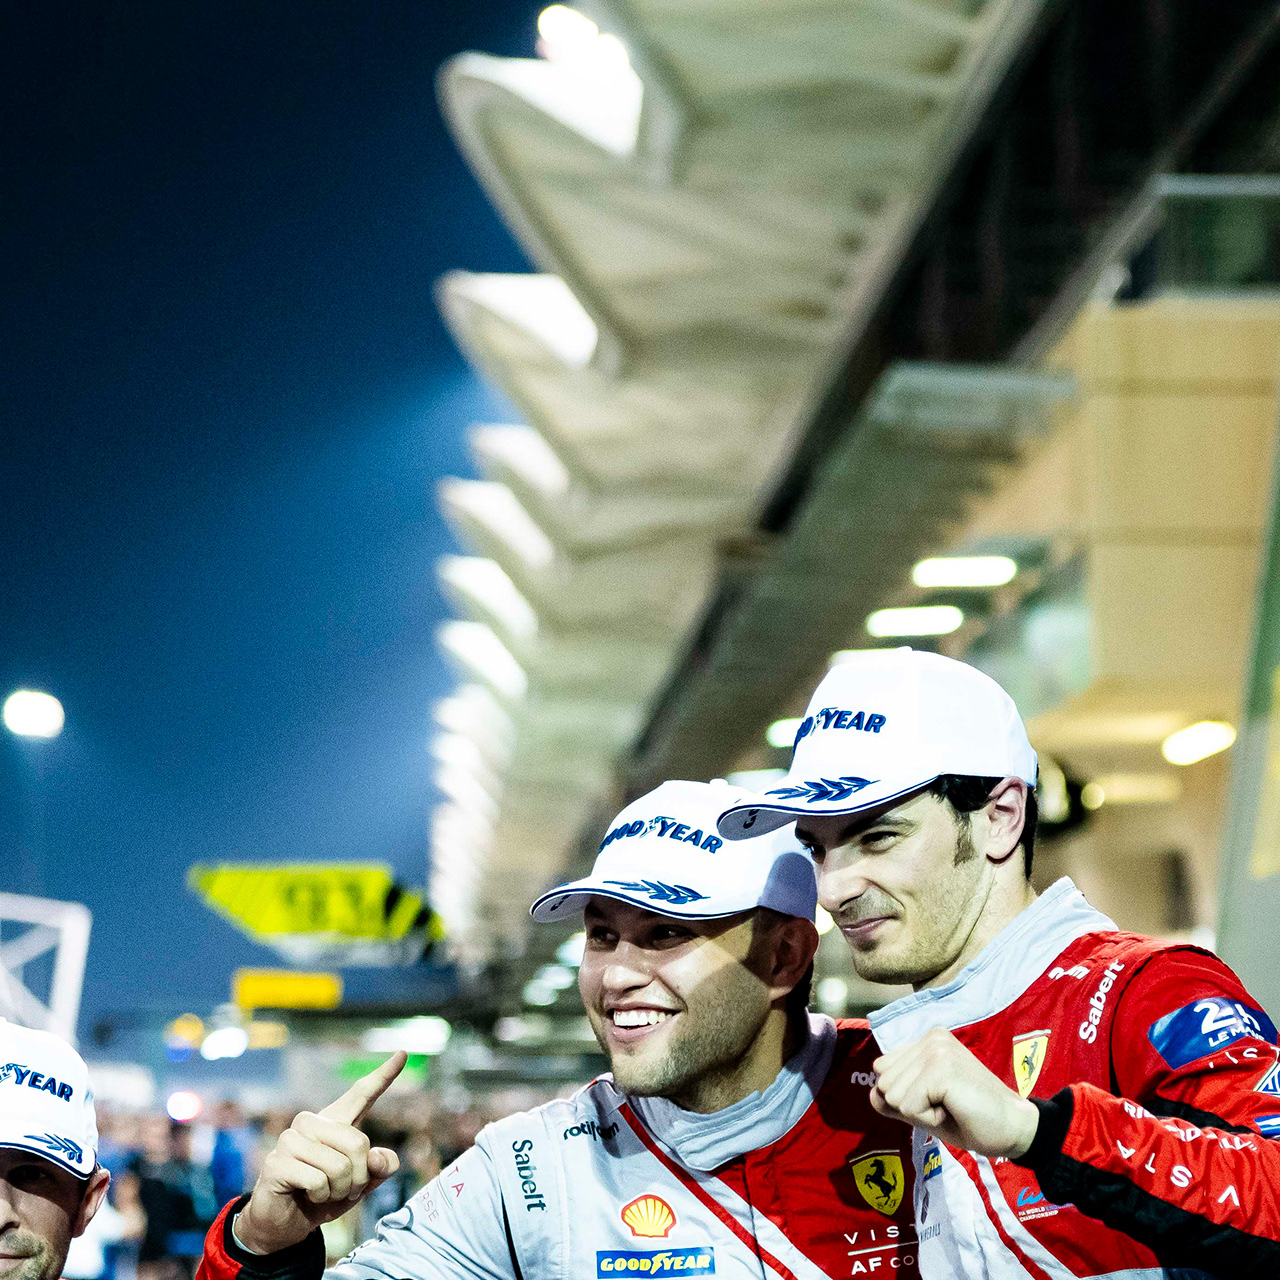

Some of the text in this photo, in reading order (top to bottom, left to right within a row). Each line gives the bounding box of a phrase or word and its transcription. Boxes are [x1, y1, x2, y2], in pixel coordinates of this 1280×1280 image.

[1078, 958, 1124, 1045] Sabelt
[1208, 1031, 1230, 1047] LE
[512, 1139, 547, 1212] Sabelt
[600, 1252, 711, 1276] GOODYEAR
[851, 1256, 882, 1276] AF
